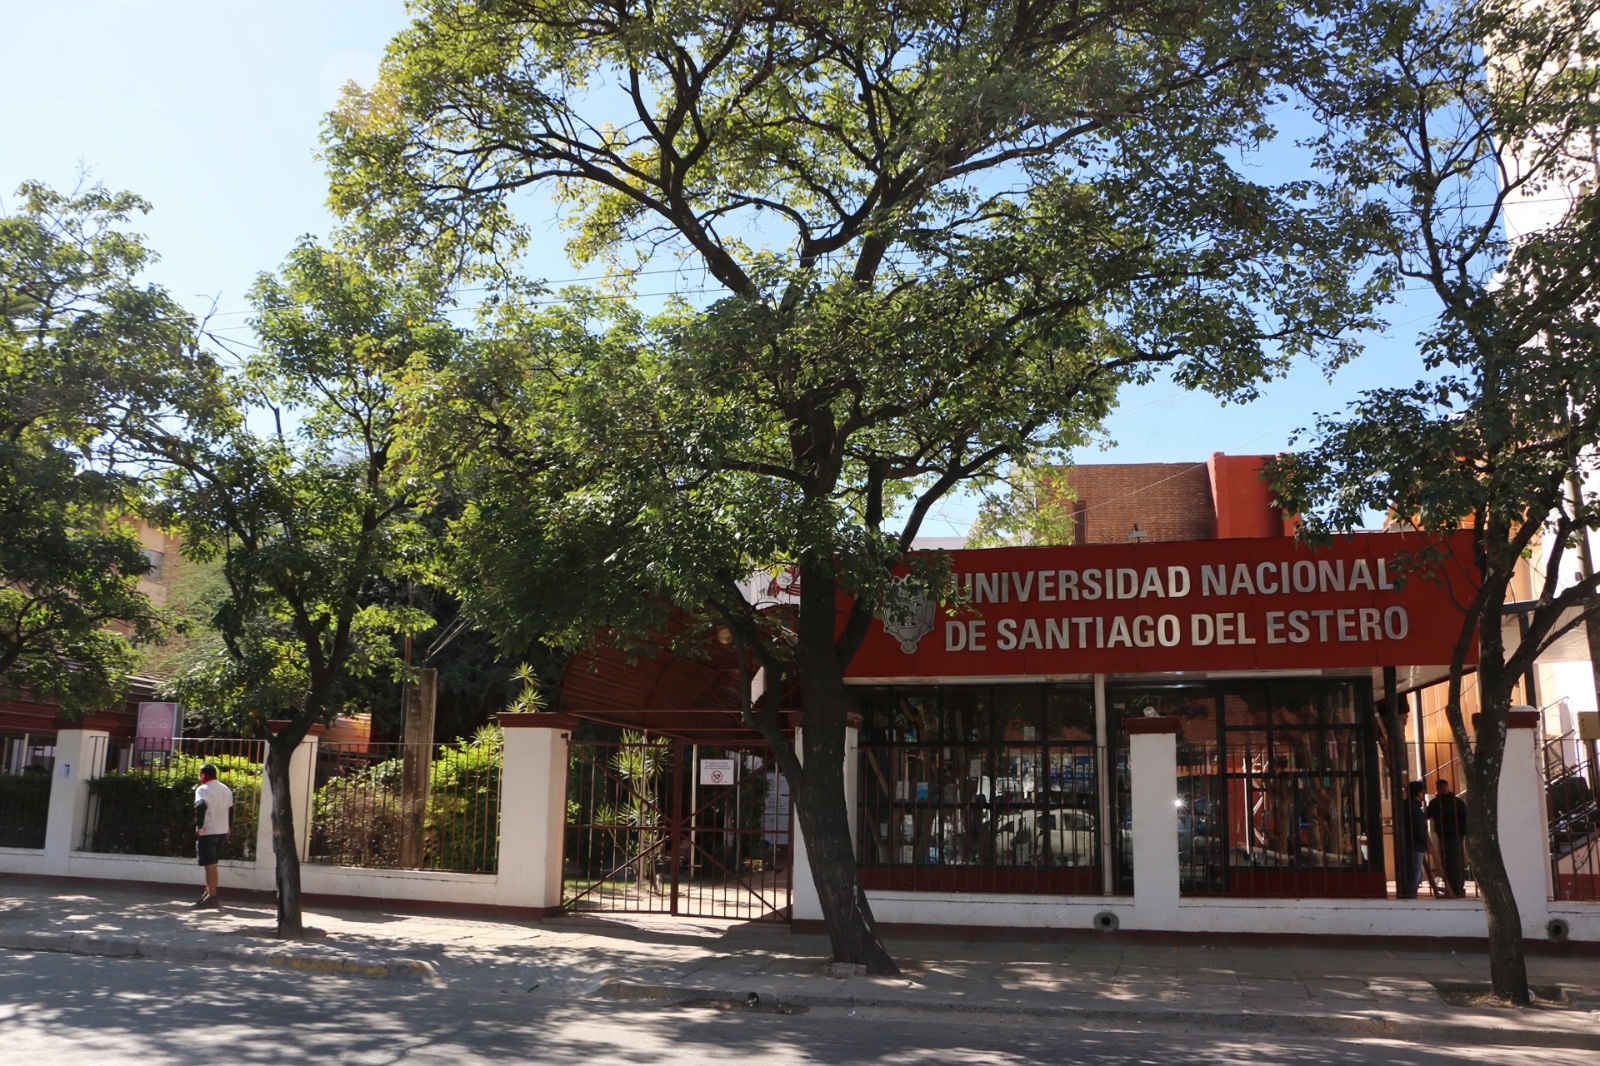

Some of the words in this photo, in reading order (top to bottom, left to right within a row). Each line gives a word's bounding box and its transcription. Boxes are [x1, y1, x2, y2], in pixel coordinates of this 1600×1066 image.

[953, 565, 1191, 604] UNIVERSIDAD
[1201, 558, 1395, 597] NACIONAL
[945, 620, 987, 651] DE
[996, 614, 1181, 651] SANTIAGO
[1191, 612, 1256, 646] DEL
[1266, 606, 1409, 644] ESTERO
